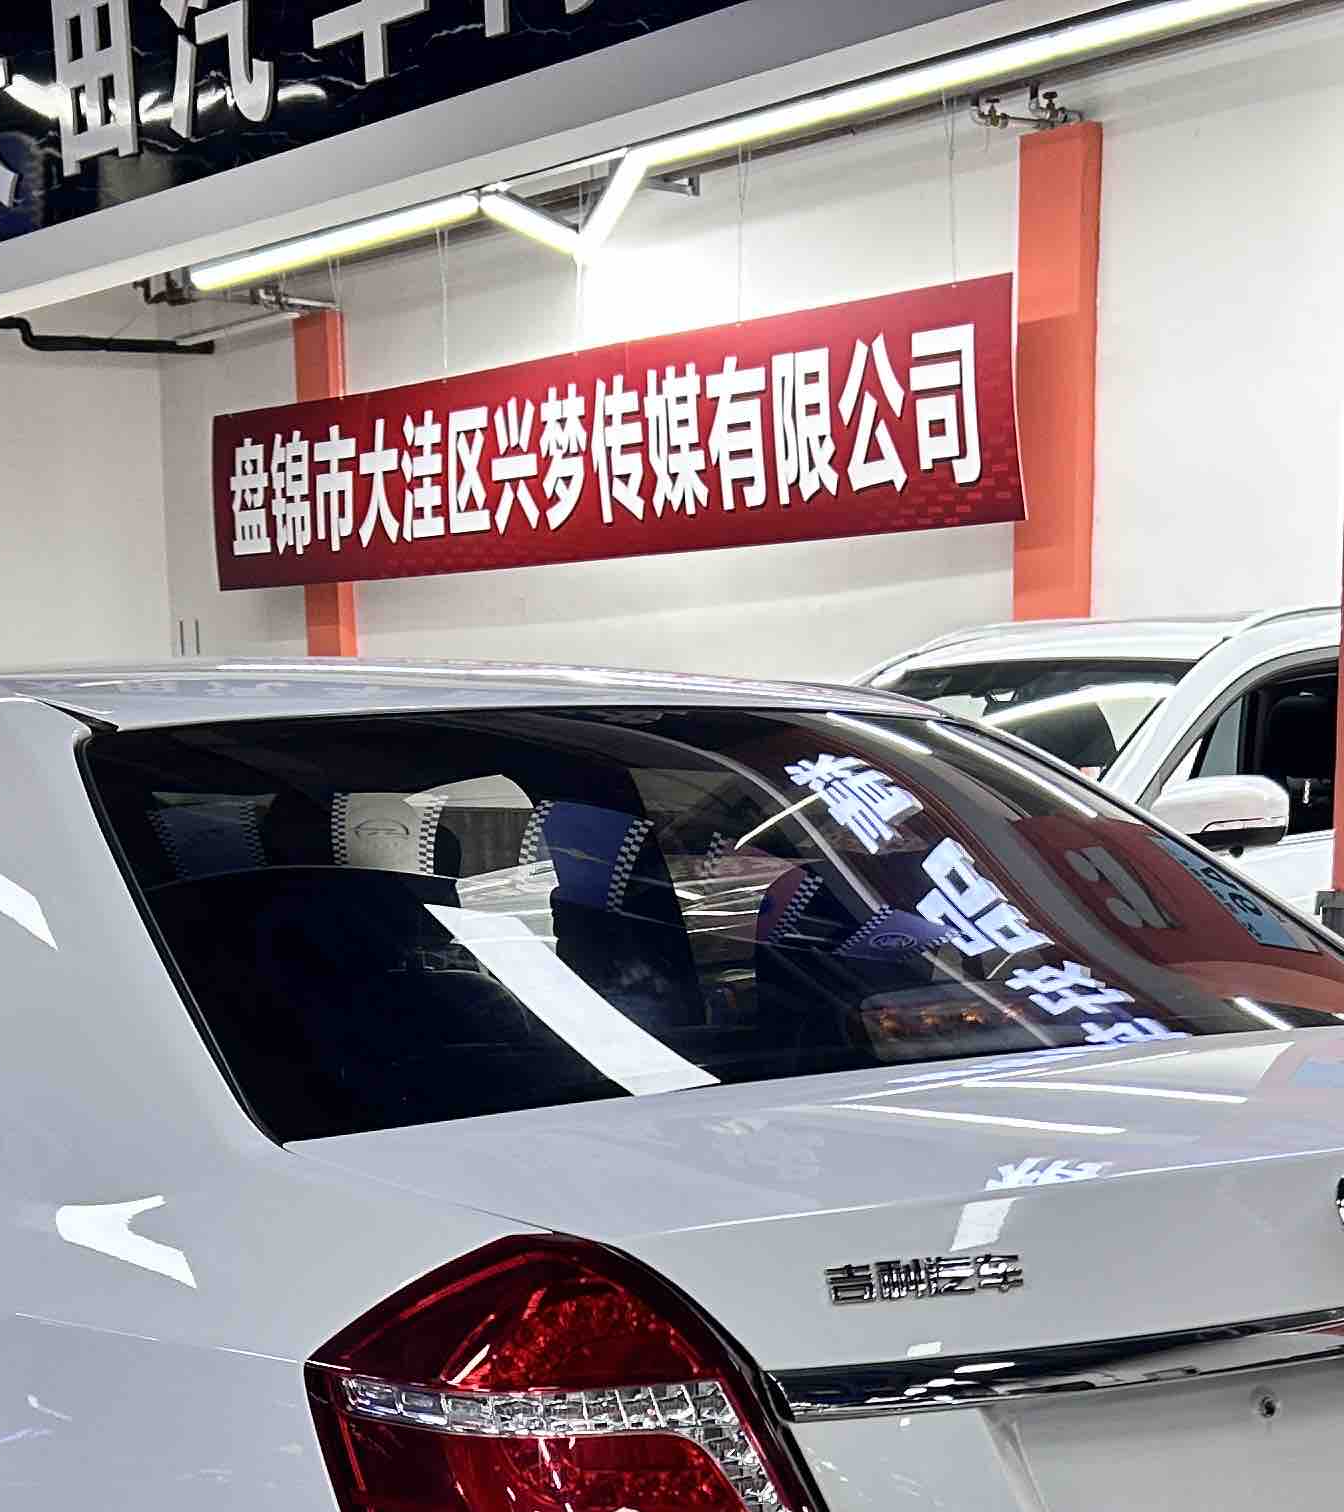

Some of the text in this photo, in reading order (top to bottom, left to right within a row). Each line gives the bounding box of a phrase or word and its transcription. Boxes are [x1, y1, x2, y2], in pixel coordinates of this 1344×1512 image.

[230, 322, 983, 557] 盘锦市大洼区兴梦传媒有限公司
[824, 1253, 1024, 1304] 吉利汽车
